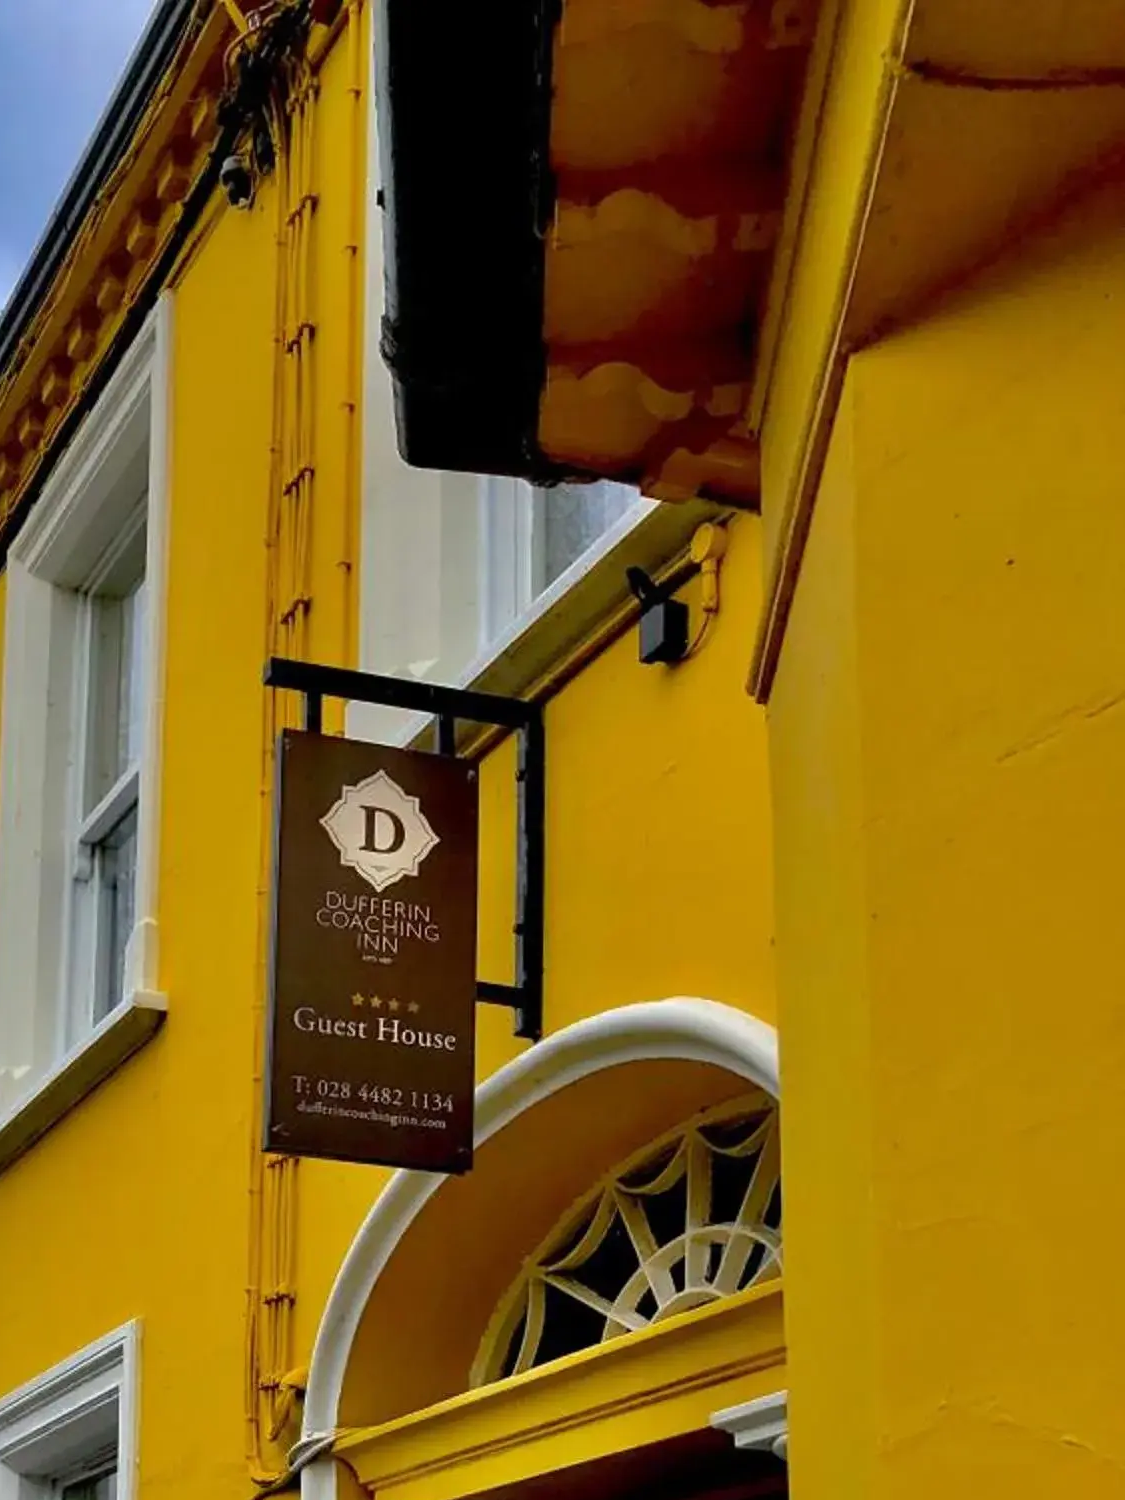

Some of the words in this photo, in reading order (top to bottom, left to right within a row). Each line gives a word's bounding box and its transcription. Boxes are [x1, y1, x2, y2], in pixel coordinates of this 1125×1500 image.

[359, 805, 406, 854] D
[316, 907, 440, 942] COACHING
[326, 891, 430, 922] DUFFERIN
[357, 933, 398, 953] INN
[293, 1007, 368, 1039] Guest
[378, 1017, 456, 1050] House
[291, 1075, 310, 1095] T:
[316, 1080, 351, 1099] 028
[357, 1083, 403, 1106] 4482
[411, 1091, 453, 1113] 1134
